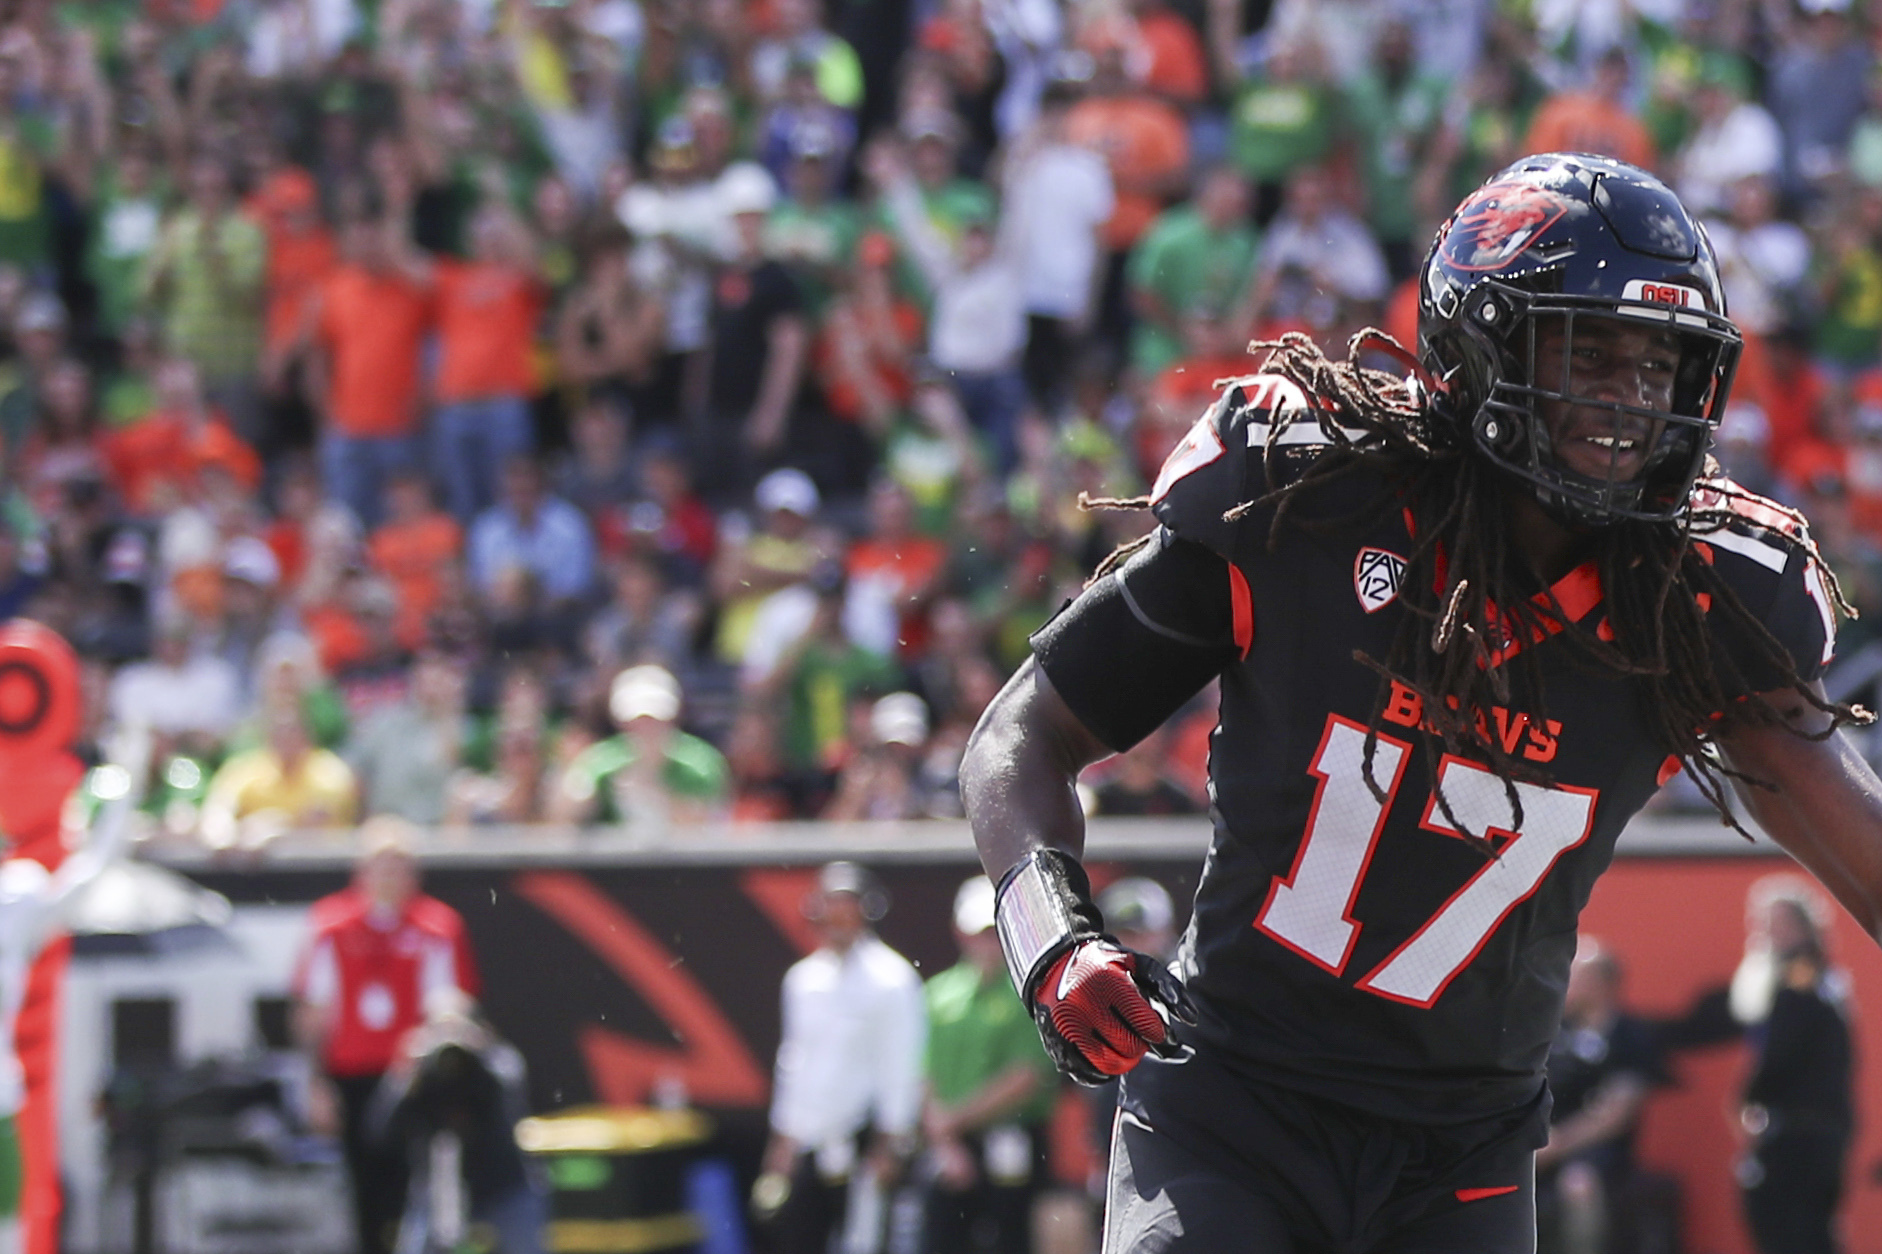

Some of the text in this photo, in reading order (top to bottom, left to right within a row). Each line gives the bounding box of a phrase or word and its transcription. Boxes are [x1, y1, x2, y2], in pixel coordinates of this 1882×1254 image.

[1641, 284, 1689, 308] OSU
[1362, 575, 1390, 601] 12
[1381, 678, 1563, 764] BVS
[1252, 712, 1599, 1010] 17
